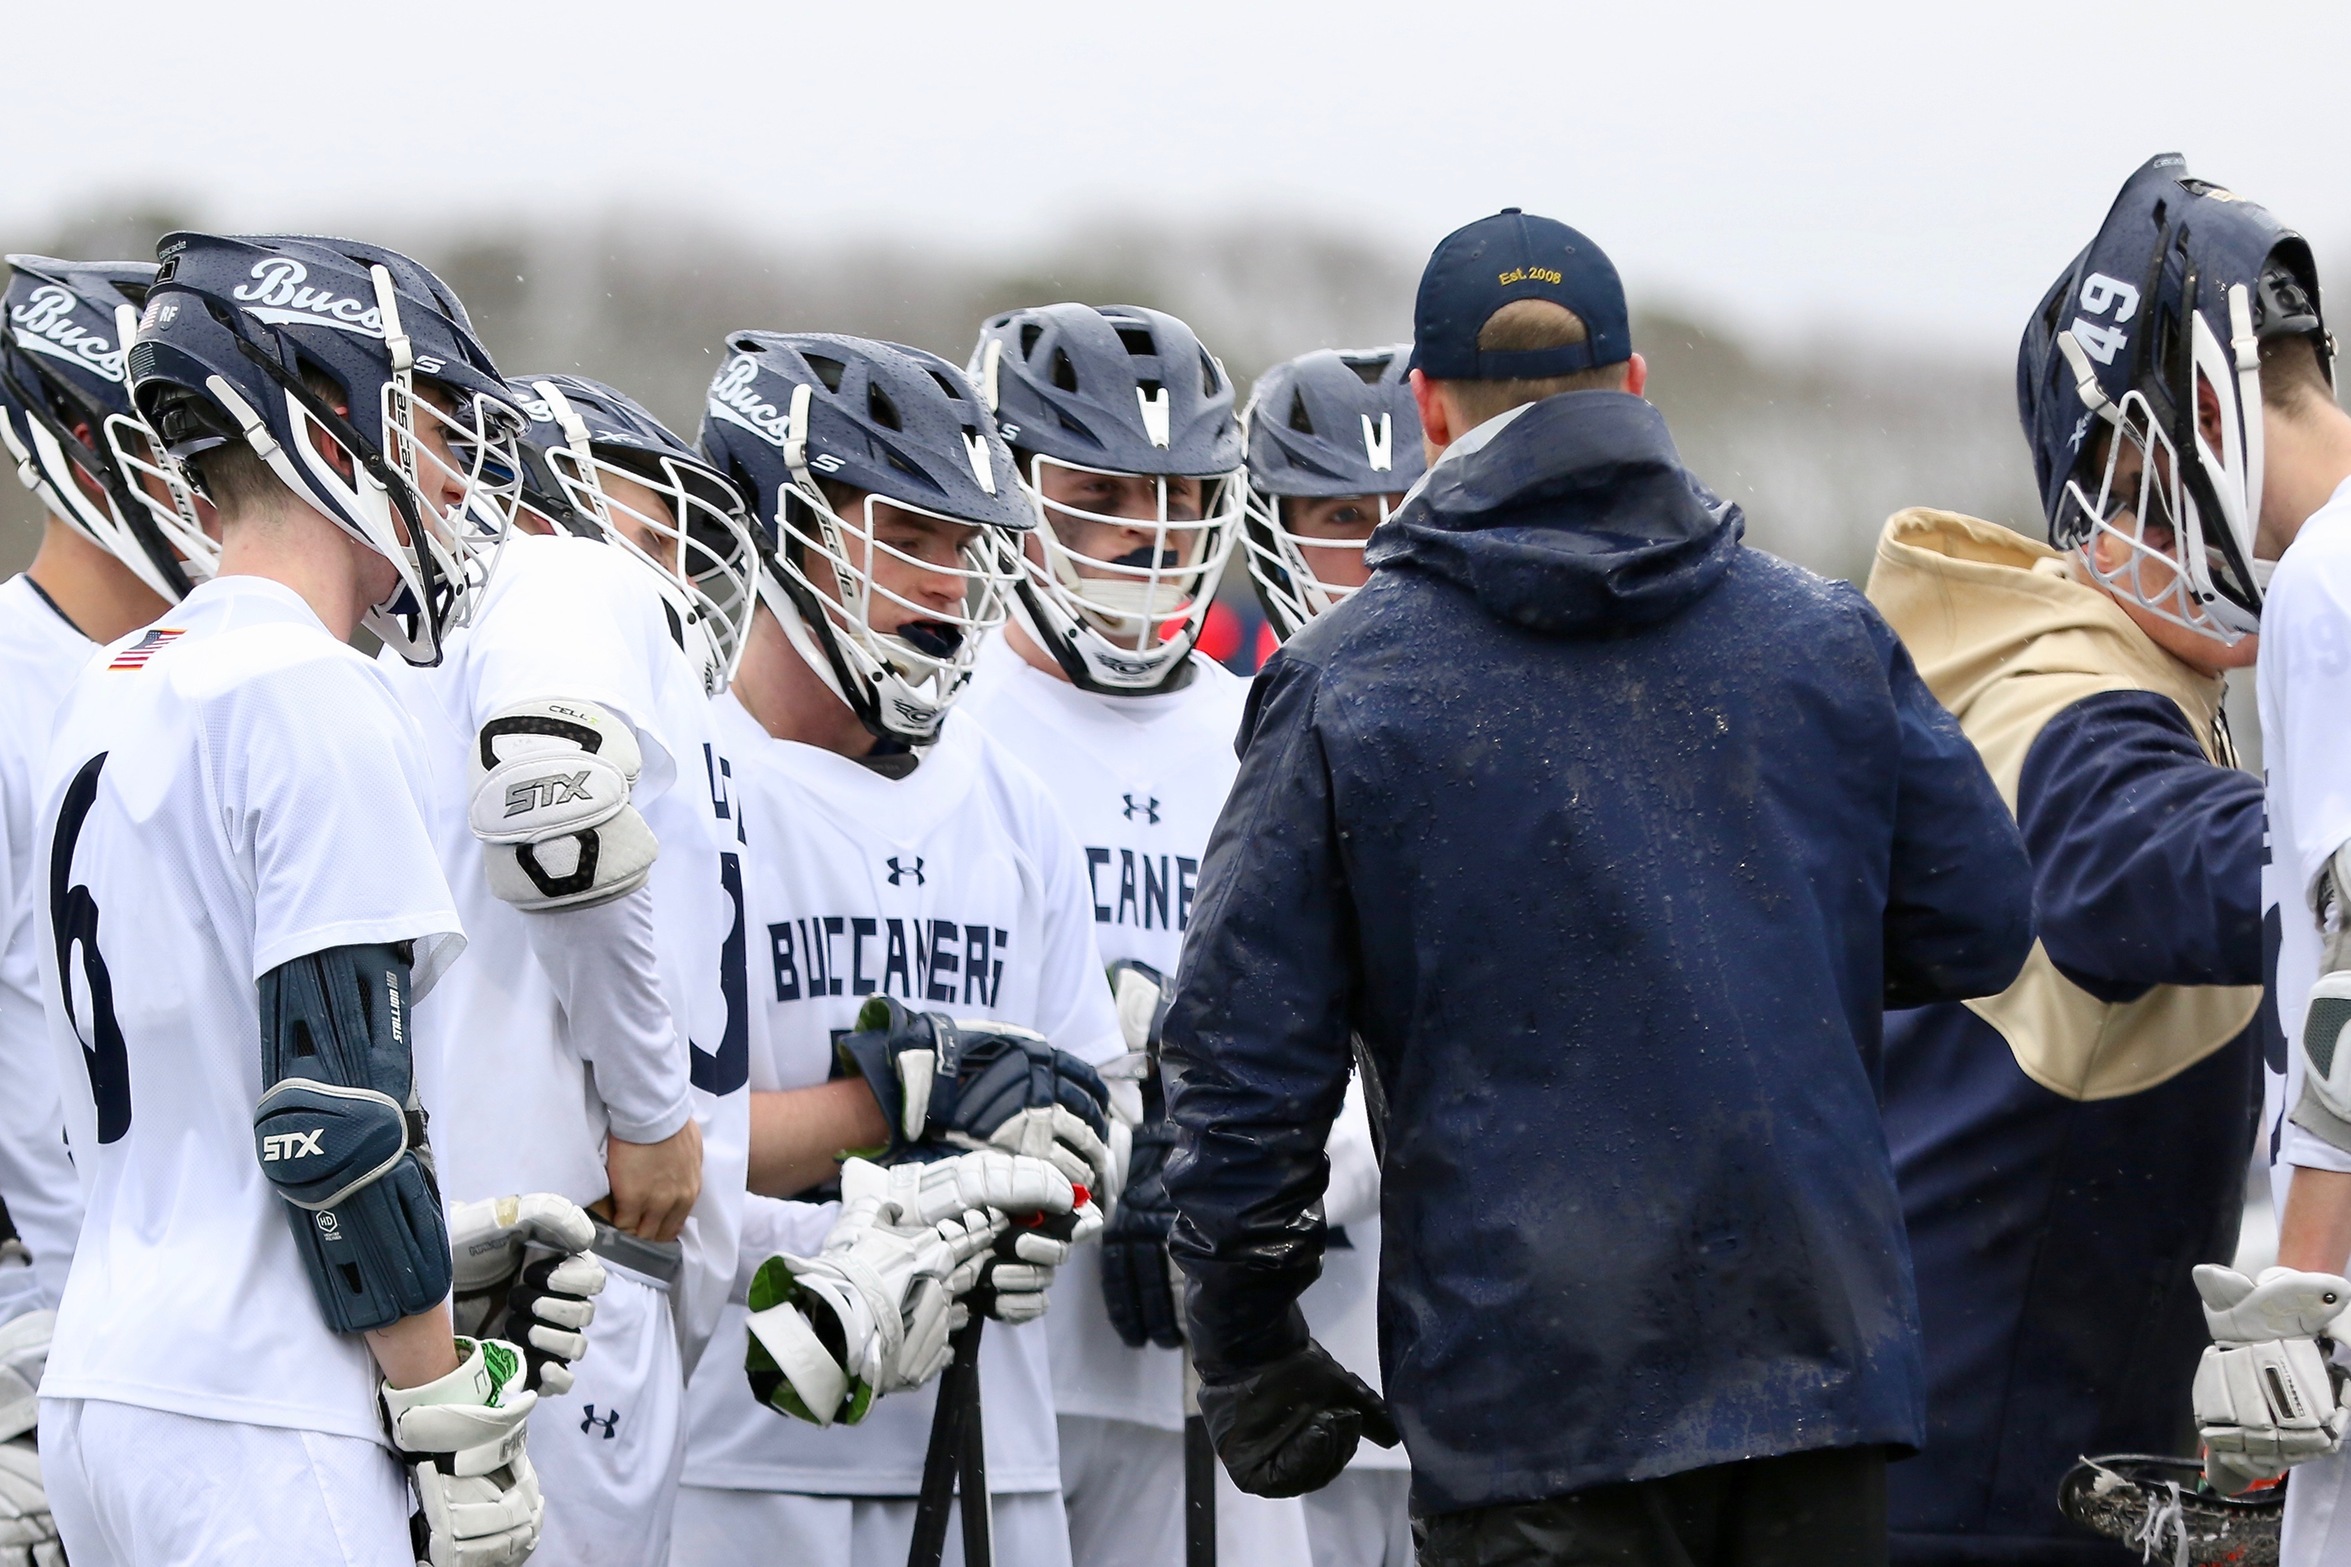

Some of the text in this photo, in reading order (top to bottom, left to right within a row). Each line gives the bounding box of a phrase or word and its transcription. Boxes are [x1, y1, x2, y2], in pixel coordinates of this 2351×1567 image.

[232, 257, 384, 333] Bucs
[1498, 266, 1562, 286] Est. 2008
[11, 284, 125, 377] Bucs
[159, 305, 178, 322] RF
[2070, 271, 2141, 366] 49
[710, 353, 791, 441] Bucs
[503, 769, 593, 819] STX
[388, 987, 404, 1045] STALLION
[263, 1128, 325, 1162] STX
[319, 1215, 335, 1227] HD
